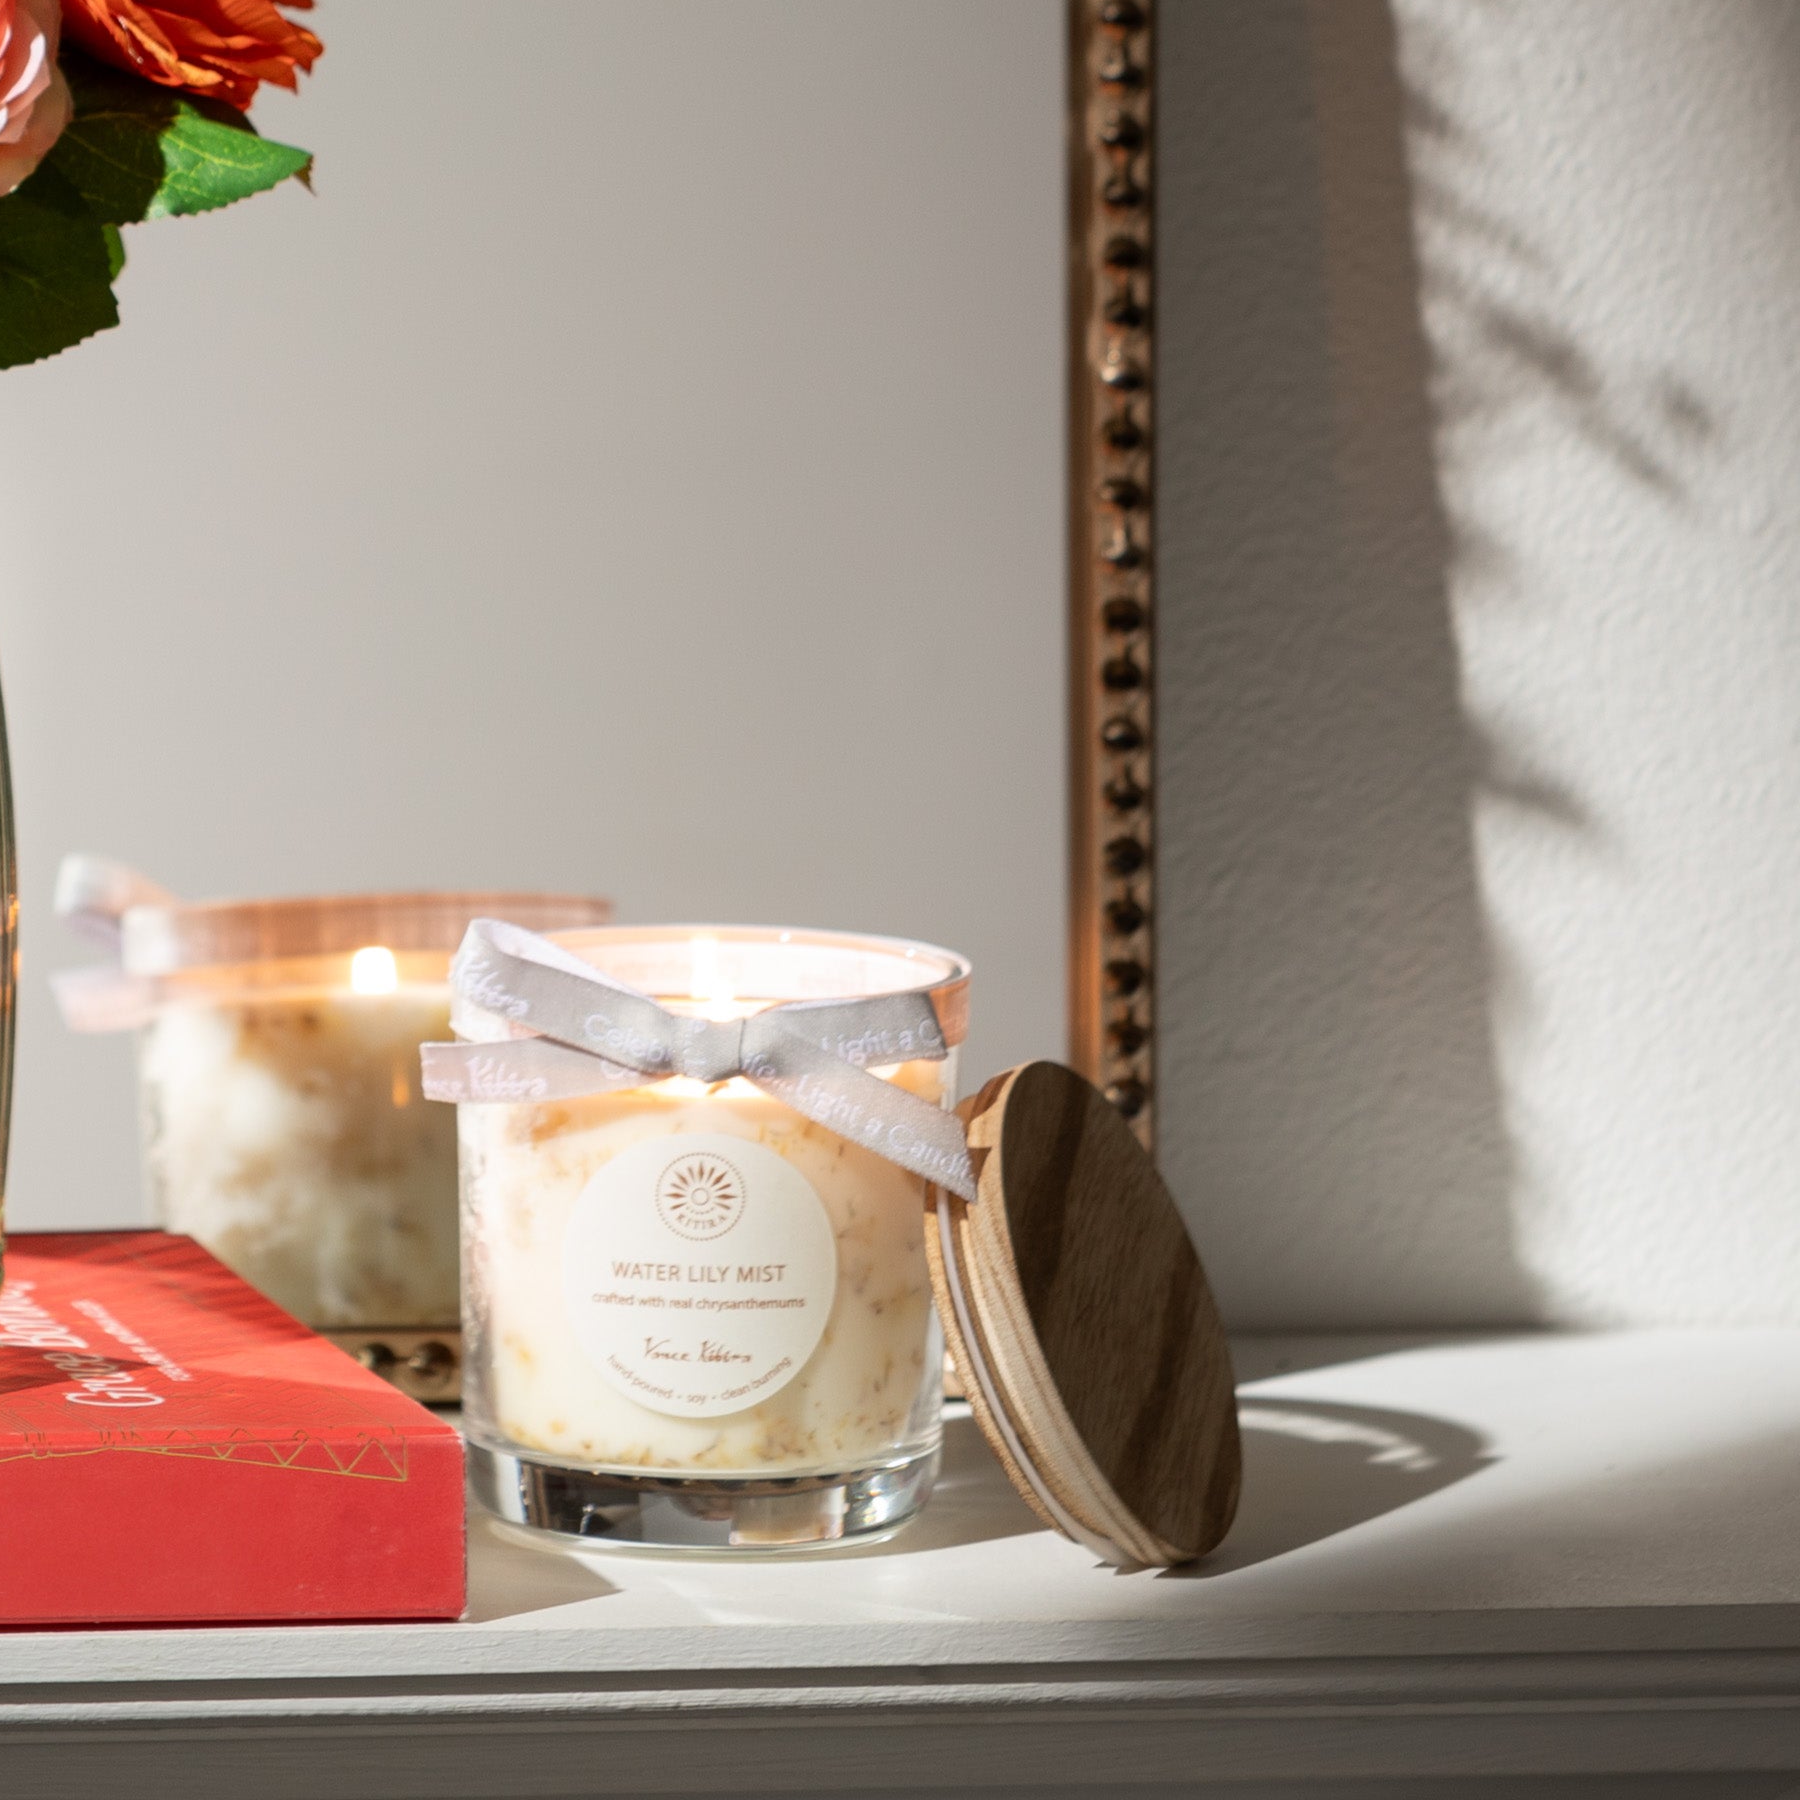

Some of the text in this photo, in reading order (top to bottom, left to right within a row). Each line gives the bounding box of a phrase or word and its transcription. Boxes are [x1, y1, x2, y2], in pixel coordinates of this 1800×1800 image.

[612, 1261, 786, 1283] WATER LILY MIST
[592, 1291, 807, 1313] crafted with real chrysanthemums
[42, 1352, 166, 1408] Grace
